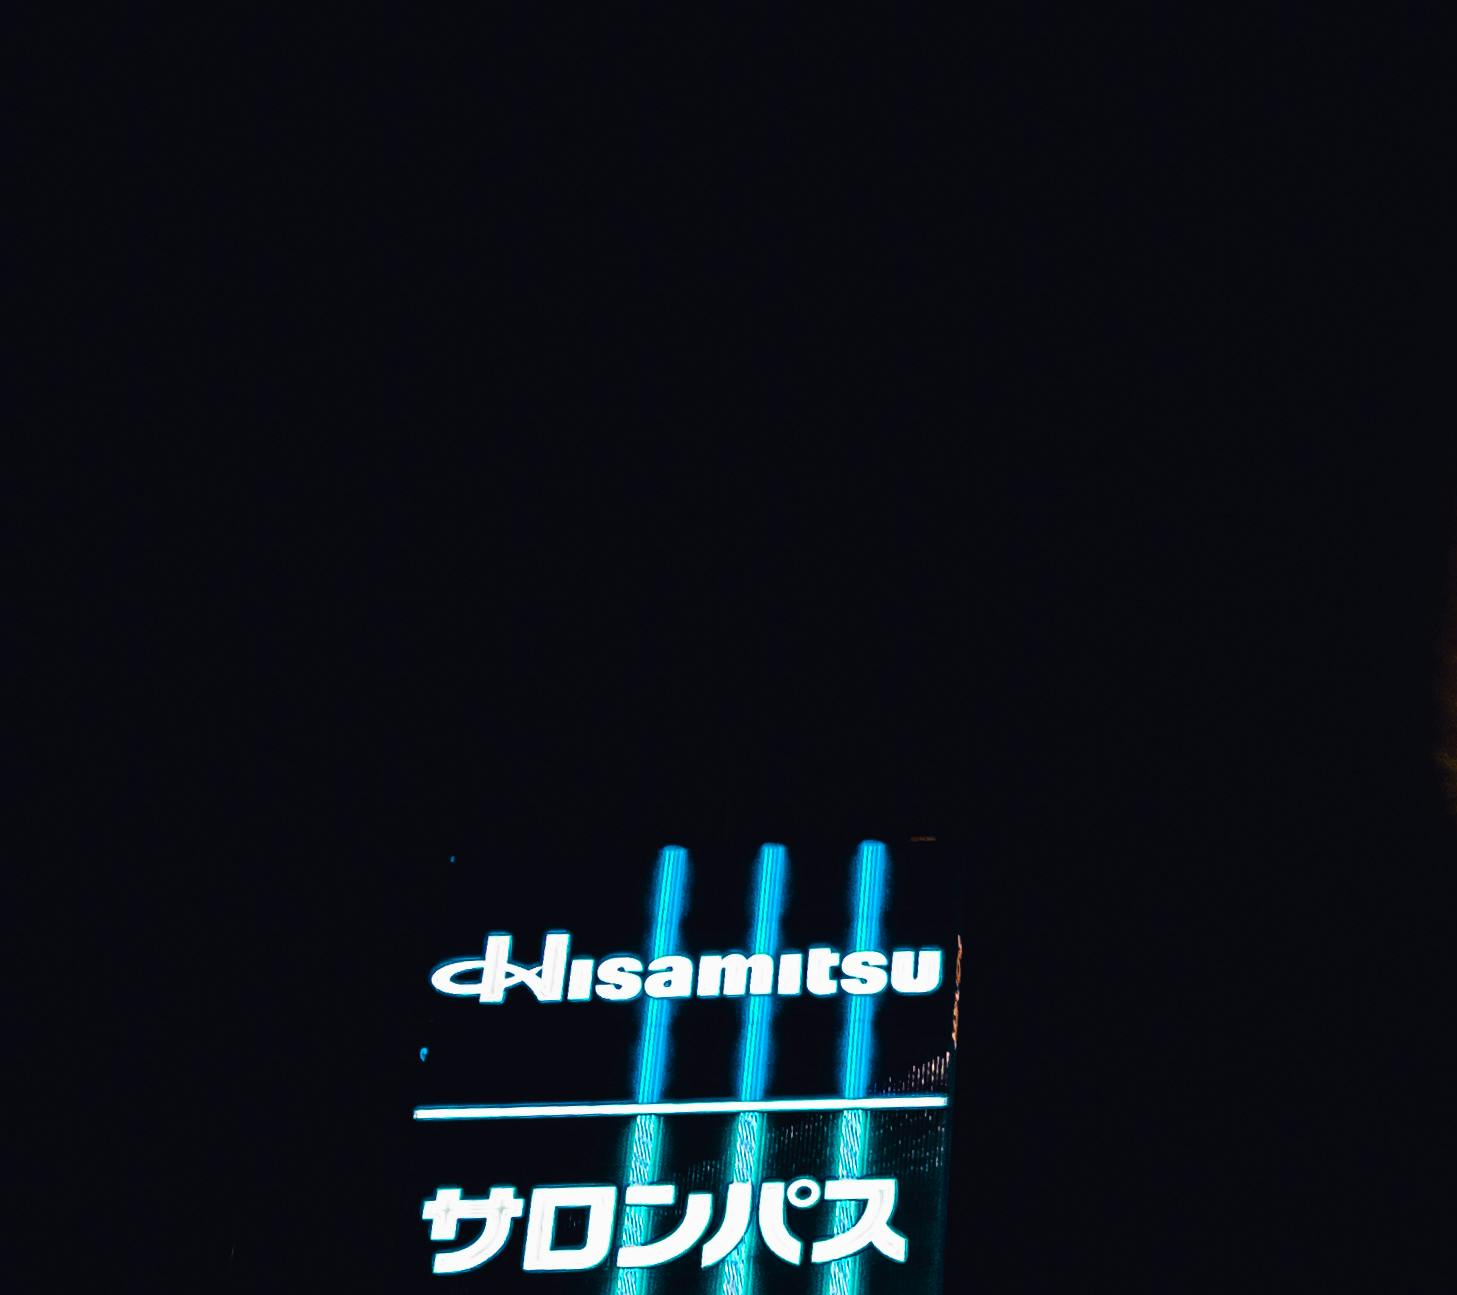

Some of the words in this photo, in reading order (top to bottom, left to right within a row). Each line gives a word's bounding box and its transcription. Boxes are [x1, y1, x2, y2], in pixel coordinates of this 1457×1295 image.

[431, 931, 943, 1003] Hisamitsu
[421, 1178, 908, 1274] サロンパス
